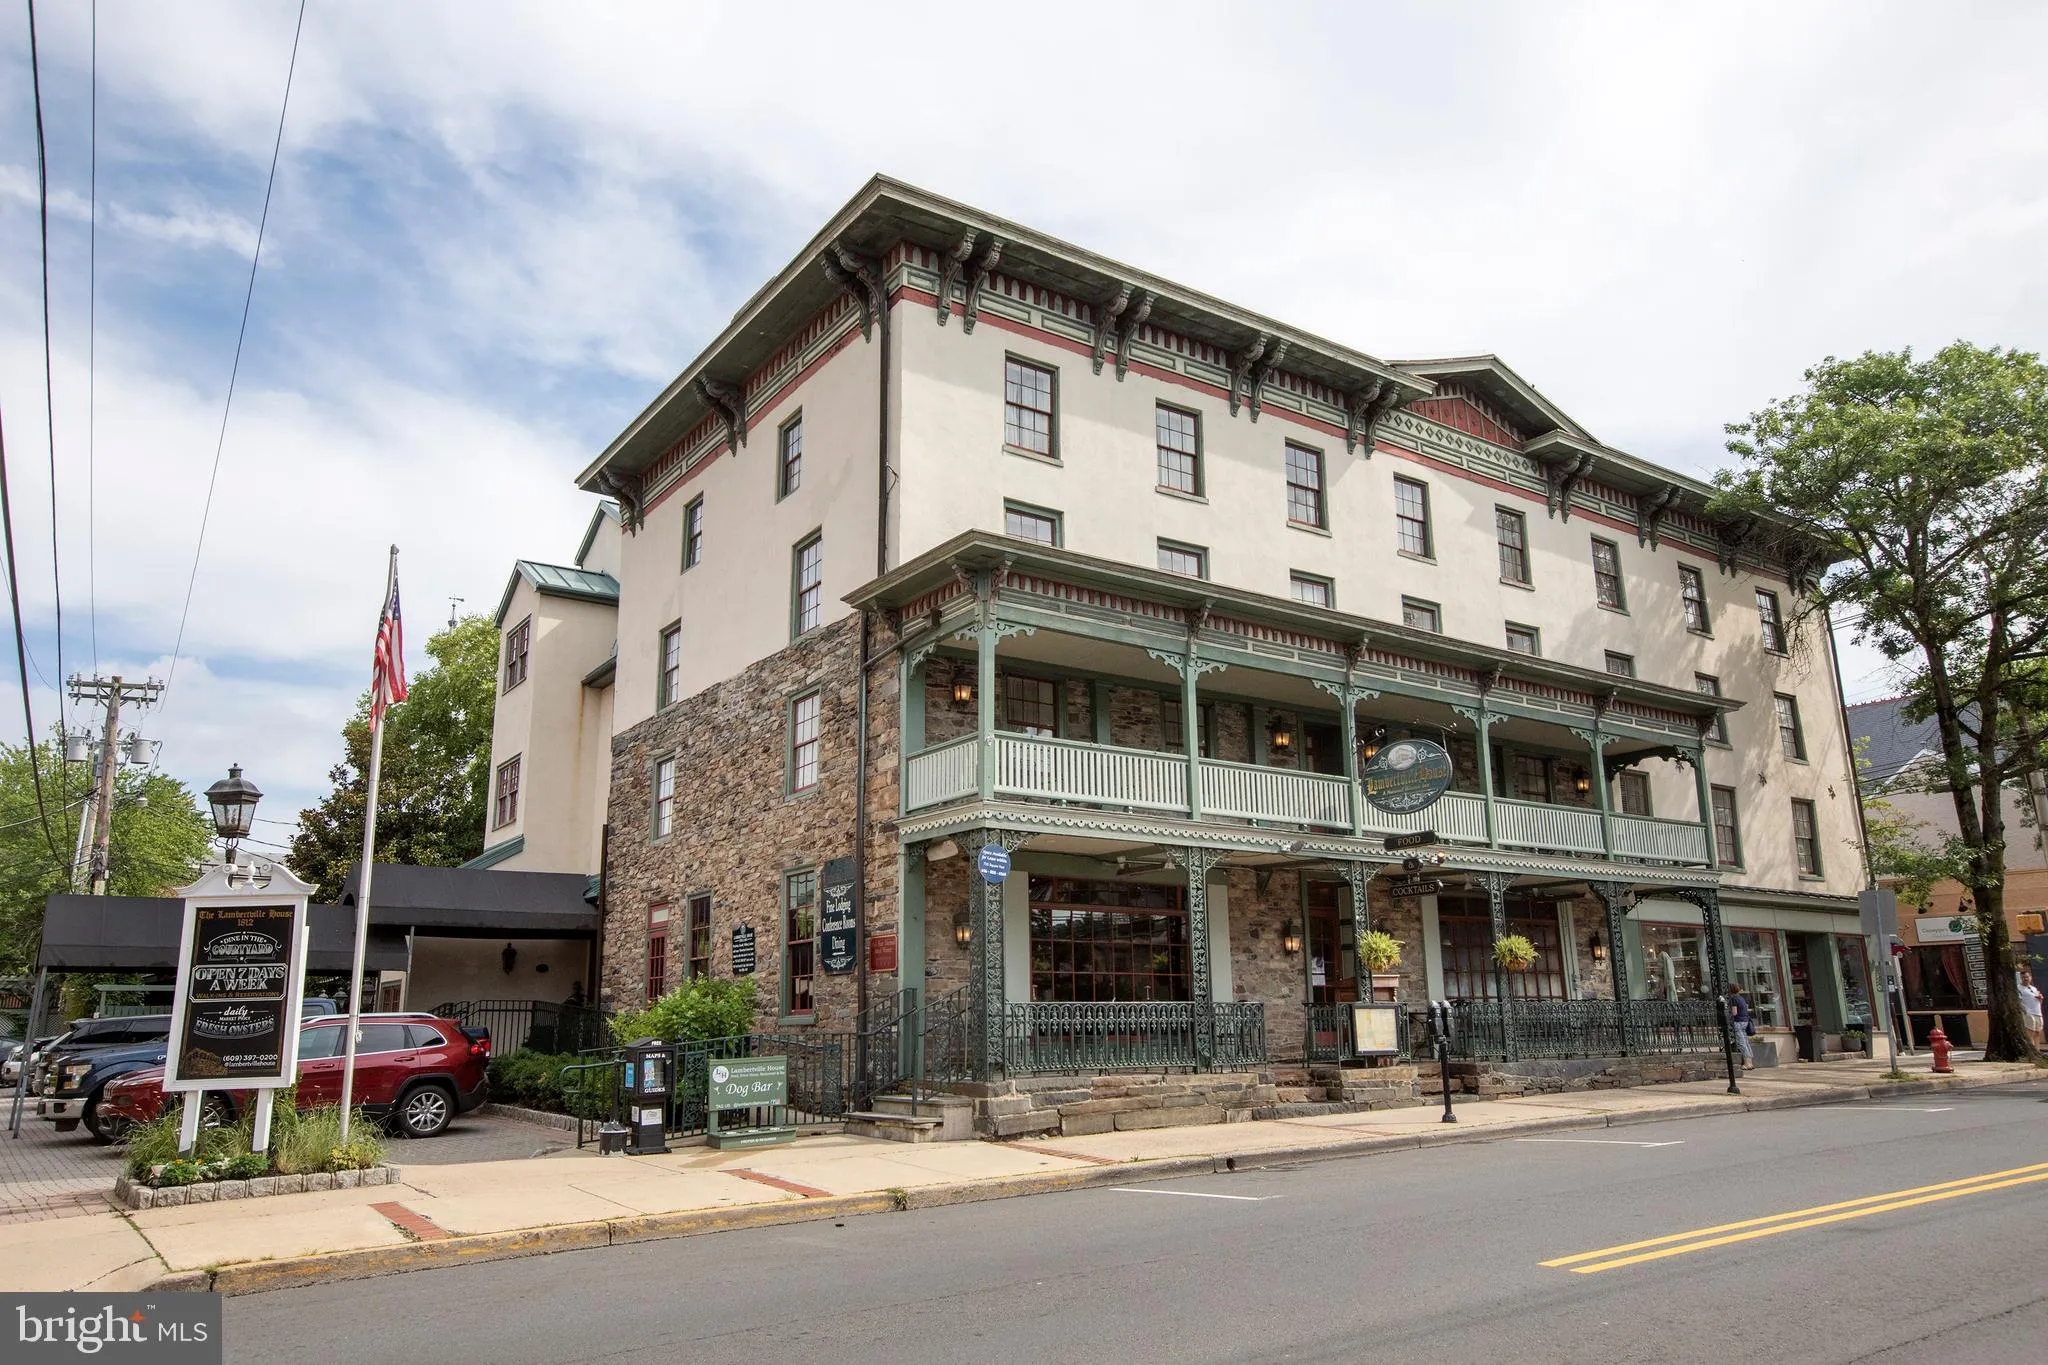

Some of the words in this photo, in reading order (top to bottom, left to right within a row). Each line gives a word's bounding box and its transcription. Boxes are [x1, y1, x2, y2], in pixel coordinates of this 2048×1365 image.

[1398, 836, 1420, 846] FOOD
[1393, 884, 1434, 896] COCKTAILS
[826, 900, 835, 913] Fine
[835, 898, 851, 914] Lodging
[199, 911, 214, 919] The
[217, 910, 266, 919] Lambertville
[268, 909, 293, 919] House
[822, 917, 842, 932] Conference
[843, 915, 856, 930] Rooms
[223, 935, 240, 944] DINE
[250, 935, 264, 943] THE
[832, 936, 846, 951] Dining
[212, 944, 274, 955] COURTYARD
[195, 968, 238, 980] OPEN
[238, 967, 247, 979] 7
[248, 966, 285, 979] DAYS
[209, 980, 220, 991] A
[224, 978, 268, 991] WEEK
[223, 1005, 248, 1018] daily
[195, 1019, 228, 1033] FRESH
[228, 1017, 274, 1036] OYSTERS
[725, 1083, 749, 1097] Dog
[751, 1081, 773, 1093] Bar
